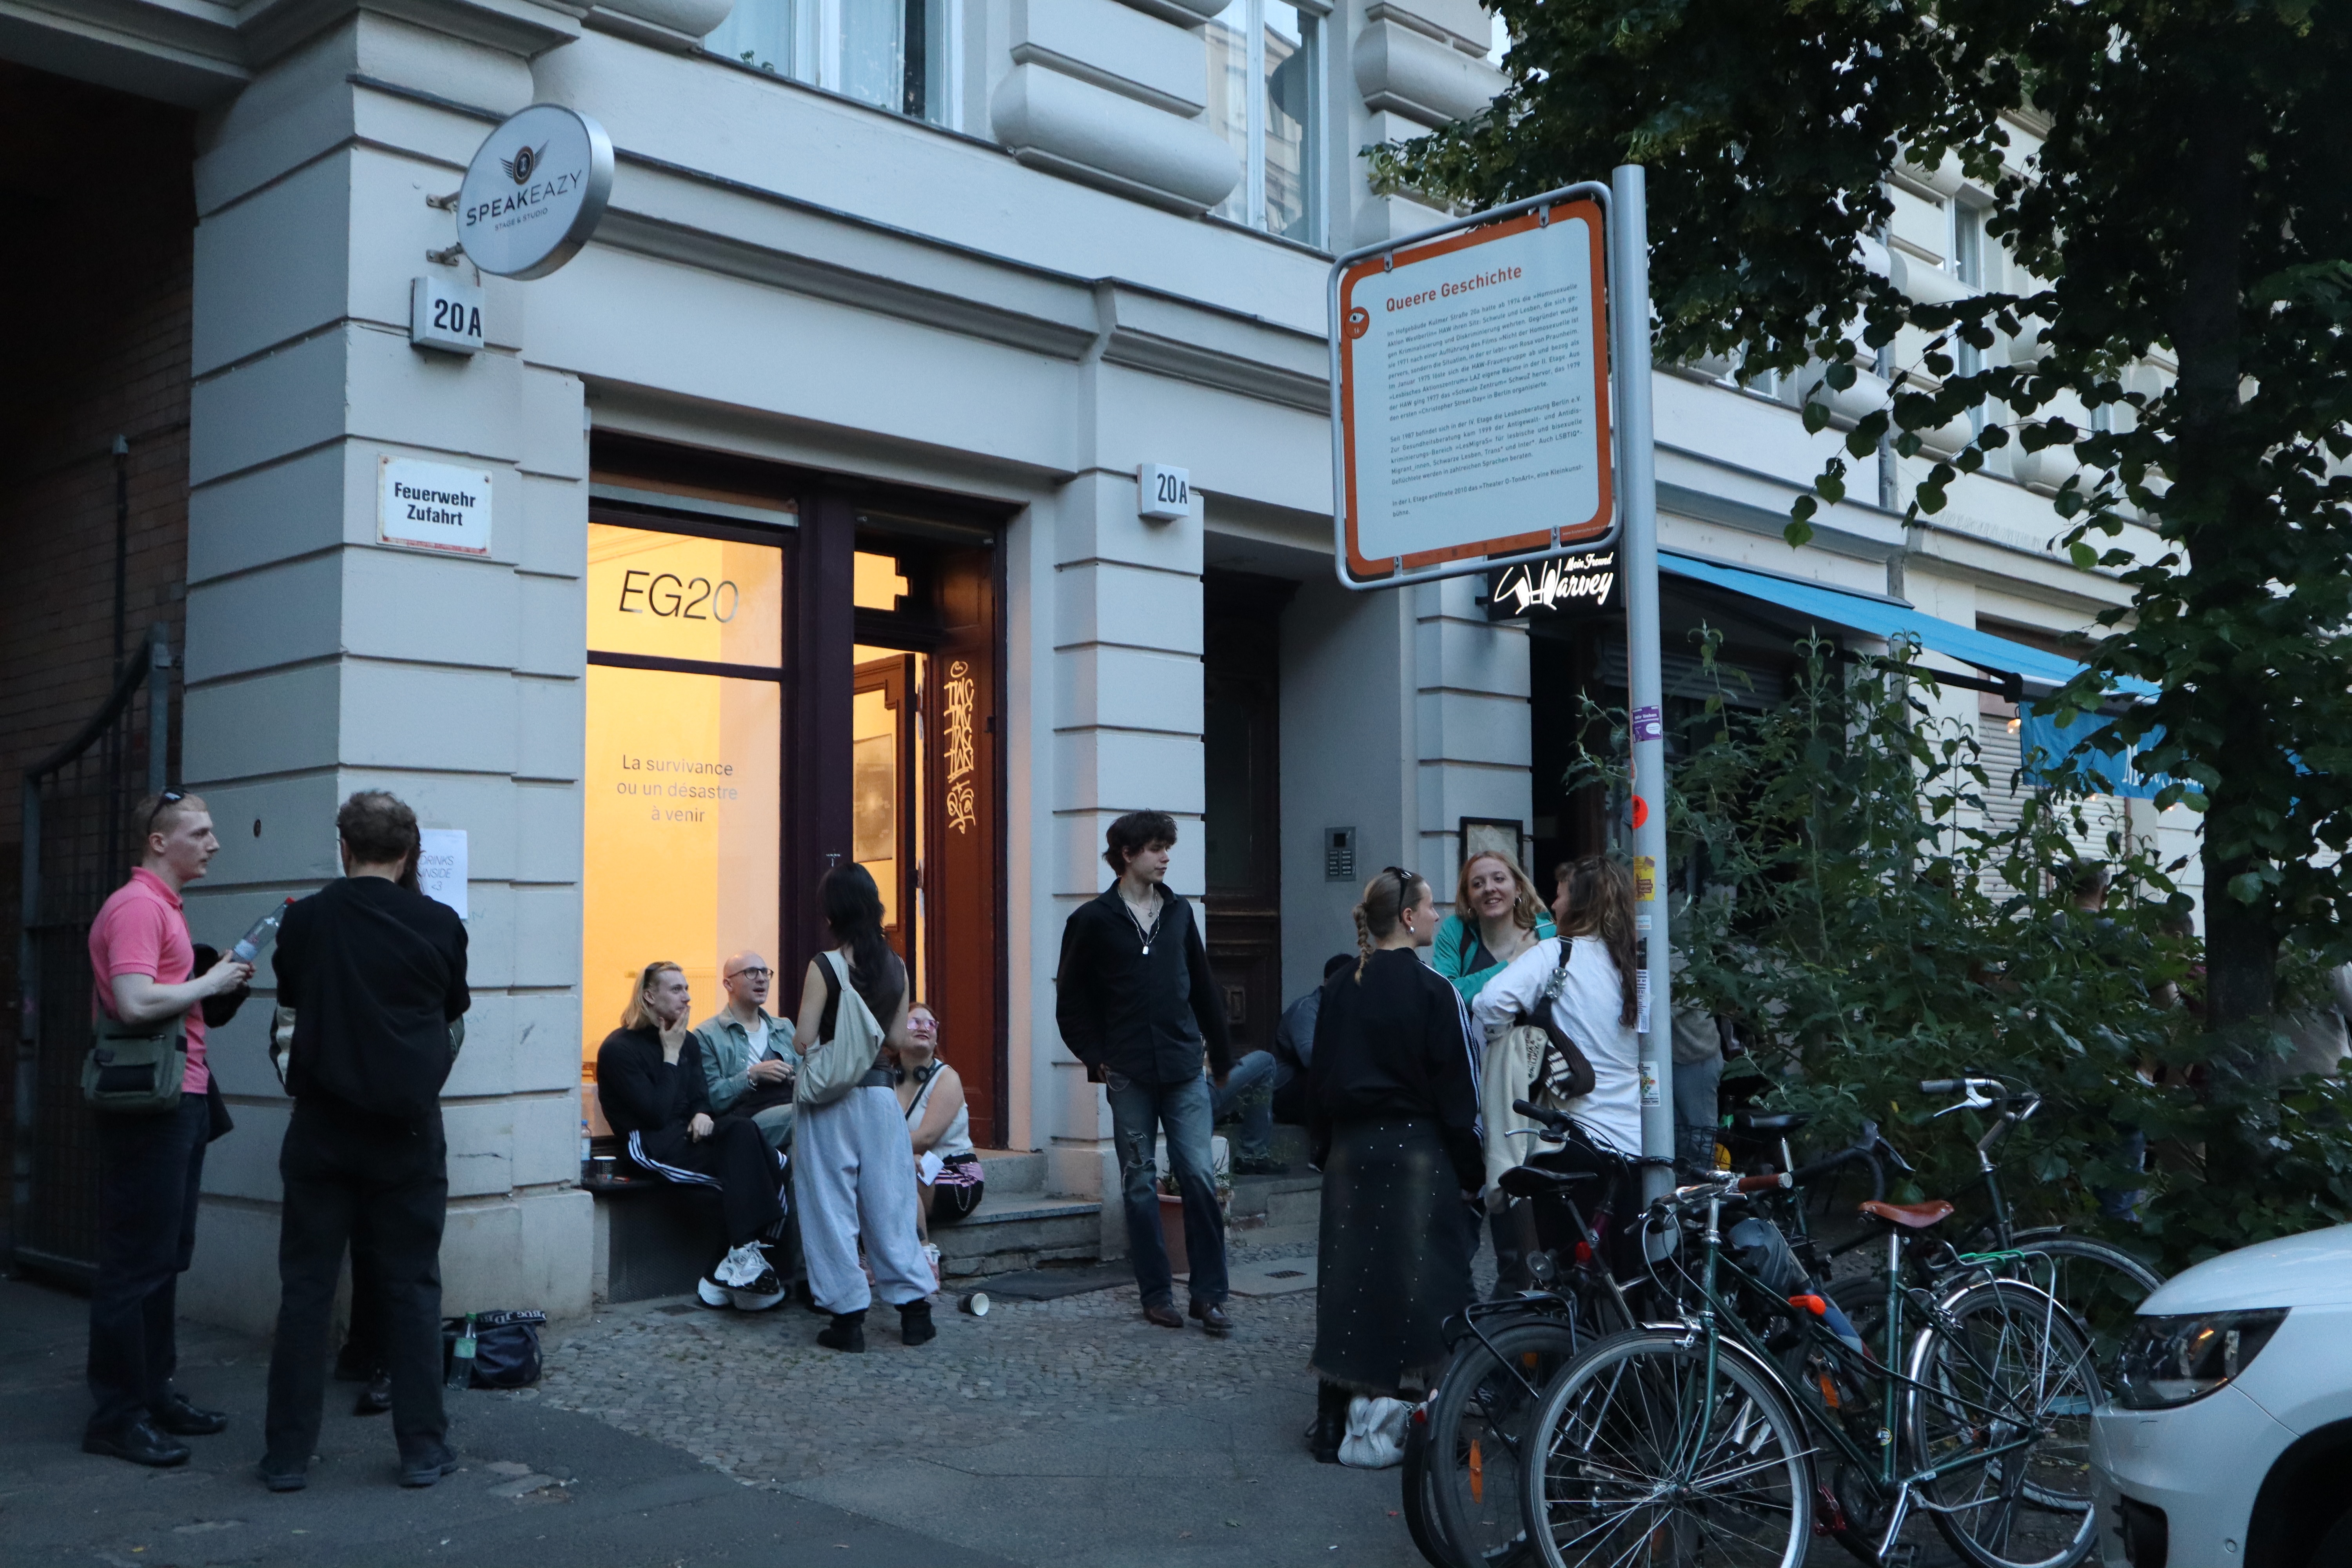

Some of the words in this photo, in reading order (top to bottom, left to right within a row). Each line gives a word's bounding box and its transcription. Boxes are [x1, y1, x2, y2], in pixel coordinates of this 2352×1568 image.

[466, 169, 582, 226] SPEAKEAZY
[495, 218, 515, 231] STAGE
[522, 207, 548, 221] STUDIO
[1387, 289, 1436, 312] Queere
[1441, 265, 1521, 298] Geschichte
[434, 298, 482, 338] 20A
[1387, 339, 1403, 347] Aktion
[1405, 331, 1437, 343] Westberlin«
[1483, 312, 1505, 323] Schwule
[1520, 304, 1542, 314] Lesben,
[1555, 296, 1566, 305] sich
[1396, 322, 1426, 334] Hofgebäude
[1428, 317, 1448, 326] Kulmer
[1450, 311, 1468, 321] Straße
[1482, 304, 1495, 312] hatte
[1508, 297, 1520, 306] 1974
[1399, 340, 1442, 355] Kriminalisierung
[1456, 325, 1500, 341] Diskriminierung
[1528, 310, 1558, 323] Gegründet
[1560, 305, 1578, 315] wurde
[1388, 370, 1409, 380] pervers,
[1411, 364, 1432, 374] sondern
[1442, 356, 1468, 366] Situation,
[1519, 339, 1533, 347] Rosa
[1545, 329, 1578, 341] Praunheim.
[1397, 358, 1408, 366] 1971
[1410, 354, 1423, 363] nach
[1439, 344, 1469, 356] Aufführung
[1482, 337, 1497, 345] Films
[1530, 319, 1570, 334] Homosexuelle
[1389, 388, 1421, 399] »Lesbisches
[1422, 378, 1467, 392] Aktionszentrum«
[1470, 373, 1480, 381] LAZ
[1482, 369, 1500, 379] eigene
[1502, 365, 1521, 374] Räume
[1549, 354, 1566, 363] Etage.
[1397, 379, 1415, 387] Januar
[1418, 374, 1430, 383] 1975
[1432, 371, 1445, 379] löste
[1448, 367, 1458, 376] sich
[1472, 352, 1526, 370] HAW-Frauengruppe
[1538, 345, 1548, 354] und
[1551, 342, 1568, 351] bezog
[1399, 400, 1412, 408] HAW
[1414, 398, 1425, 407] ging
[1427, 394, 1439, 402] 1977
[1480, 380, 1506, 390] Zentrum«
[1508, 372, 1530, 383] SchwuZ
[1532, 369, 1552, 378] hervor,
[1567, 361, 1580, 370] 1979
[1400, 410, 1417, 419] ersten
[1454, 397, 1470, 407] Street
[1494, 389, 1511, 398] Berlin
[1512, 381, 1548, 394] organisierte.
[1402, 434, 1461, 450] Gesundheitsberatung
[1479, 425, 1492, 434] 1999
[1544, 412, 1555, 420] und
[1558, 407, 1581, 417] Antidis-
[1403, 432, 1414, 440] 1987
[1416, 426, 1437, 437] befindet
[1439, 424, 1449, 432] sich
[1477, 416, 1492, 424] Etage
[1504, 403, 1550, 417] Lesbenberatung
[1551, 398, 1569, 407] Berlin
[1391, 445, 1452, 464] kriminierungs-Bereich
[1507, 428, 1534, 439] lesbische
[1537, 425, 1548, 433] und
[1552, 418, 1582, 430] bisexuelle
[1433, 456, 1459, 466] Schwarze
[1461, 451, 1482, 460] Lesben,
[1505, 443, 1516, 451] und
[1539, 435, 1553, 444] Auch
[1422, 470, 1442, 479] werden
[1450, 462, 1481, 473] zahlreichen
[1482, 457, 1508, 467] Sprachen
[1510, 452, 1533, 461] beraten.
[394, 482, 476, 508] Feuerwehr
[1157, 473, 1188, 505] 20A
[1428, 489, 1453, 499] eröffnete
[1454, 486, 1467, 494] 2010
[407, 504, 463, 526] Zufahrt
[1564, 556, 1584, 571] Mein
[1584, 552, 1613, 569] Freund
[619, 570, 739, 623] EG20
[1494, 558, 1614, 615] Harvey
[623, 755, 641, 769] La
[646, 759, 733, 776] survivance
[617, 782, 637, 794] ou
[643, 784, 662, 796] un
[668, 782, 737, 800] désastre
[652, 805, 660, 821] à
[665, 808, 705, 822] venir
[419, 855, 454, 865] DRINKS
[421, 868, 452, 878] INSIDE
